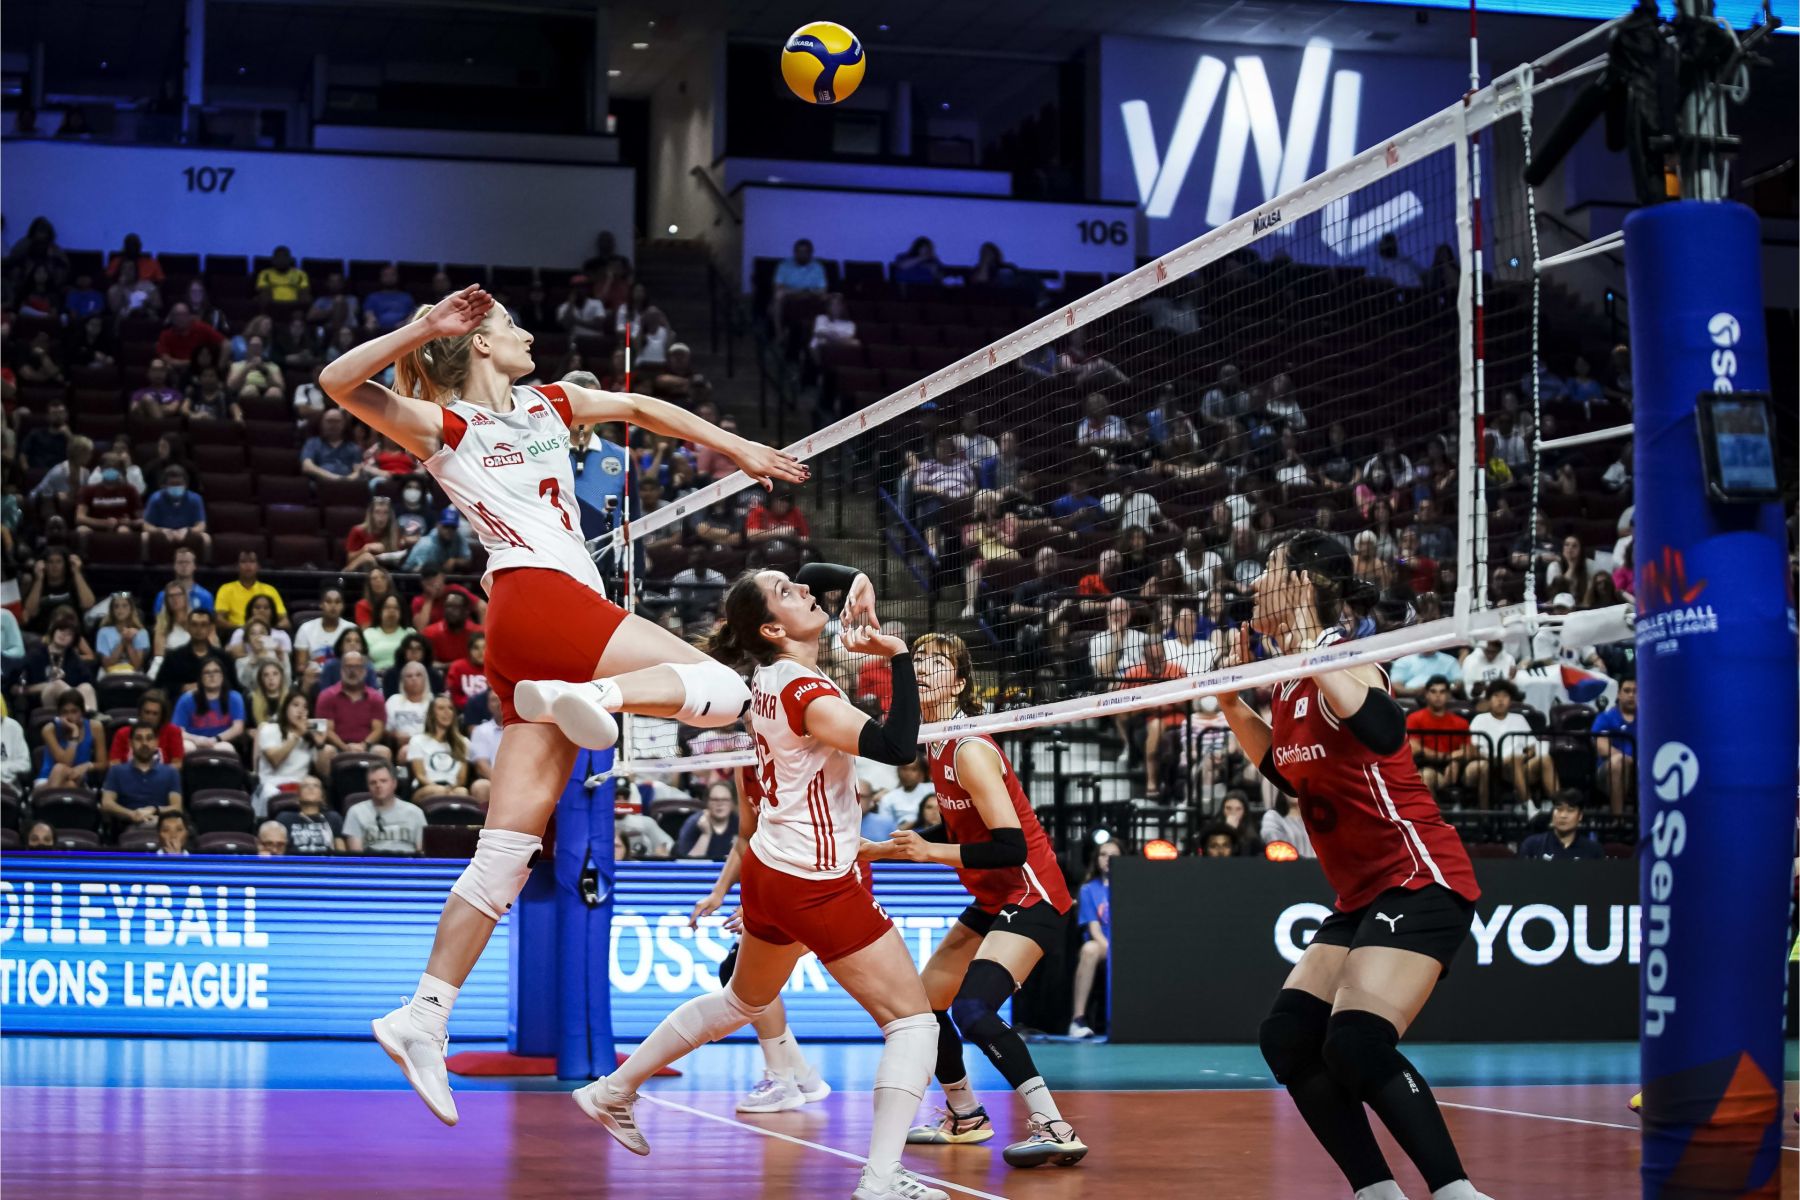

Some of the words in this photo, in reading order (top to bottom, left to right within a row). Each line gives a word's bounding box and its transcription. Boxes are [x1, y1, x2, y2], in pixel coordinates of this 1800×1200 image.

[1119, 36, 1424, 258] VNL
[182, 166, 235, 192] 107
[1076, 220, 1129, 247] 106
[484, 454, 522, 467] ORLEN
[527, 438, 560, 457] plus
[794, 681, 818, 701] plus
[1276, 744, 1326, 766] Shinhan
[1645, 810, 1687, 1037] Senoh
[124, 961, 269, 1009] LEAGUE
